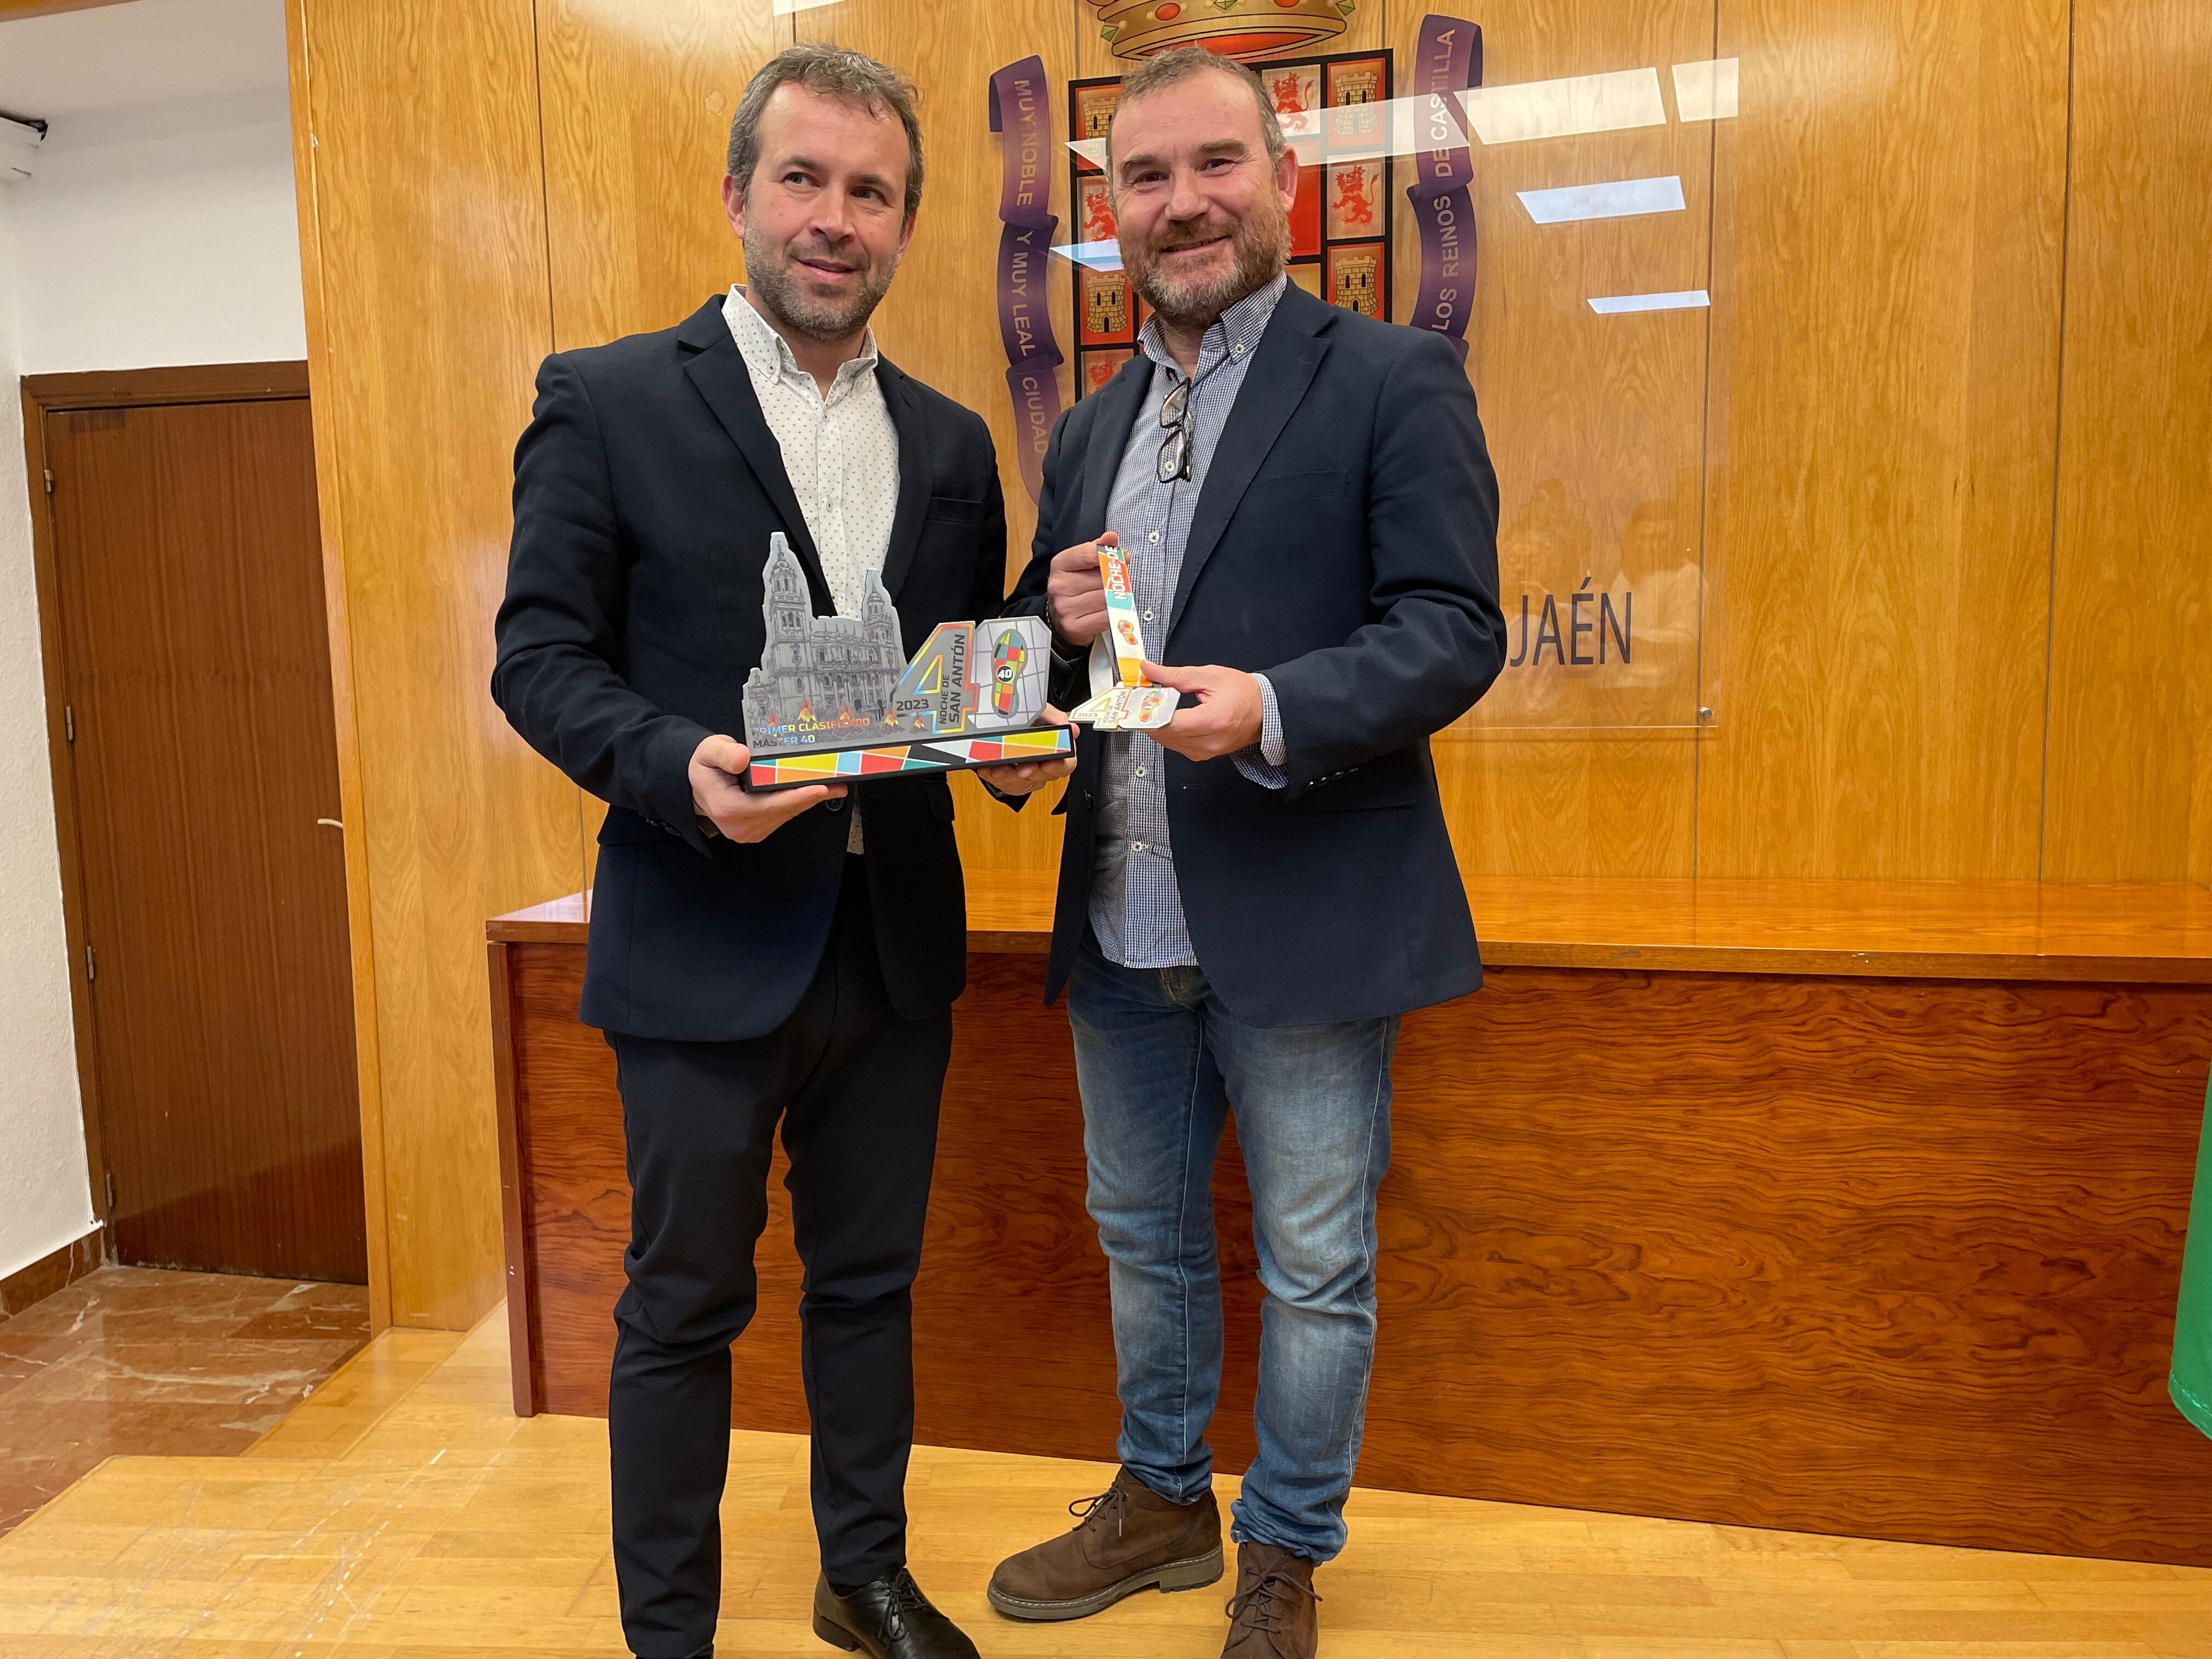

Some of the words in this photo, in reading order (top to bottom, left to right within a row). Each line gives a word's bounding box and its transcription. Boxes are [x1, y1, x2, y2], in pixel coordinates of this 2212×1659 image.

[1014, 80, 1035, 125] MUY
[1430, 29, 1455, 141] CASTILLA
[1016, 132, 1037, 206] NOBLE
[1433, 148, 1453, 177] DE
[1017, 230, 1034, 246] Y
[1434, 195, 1459, 278] REINOS
[1012, 252, 1029, 297] MUY
[1432, 288, 1457, 330] LOS
[1012, 303, 1036, 357] LEAL
[1022, 377, 1048, 456] CIUDAD
[1510, 577, 1632, 667] JAÉN
[951, 634, 966, 687] ANTÓN
[997, 669, 1013, 679] 40
[942, 674, 950, 689] DE
[896, 699, 929, 711] 2023
[939, 690, 949, 724] NOCHE
[949, 692, 961, 723] SAN
[1108, 711, 1119, 723] SAN
[799, 718, 870, 732] CLASIFICADO
[800, 734, 816, 744] 40
